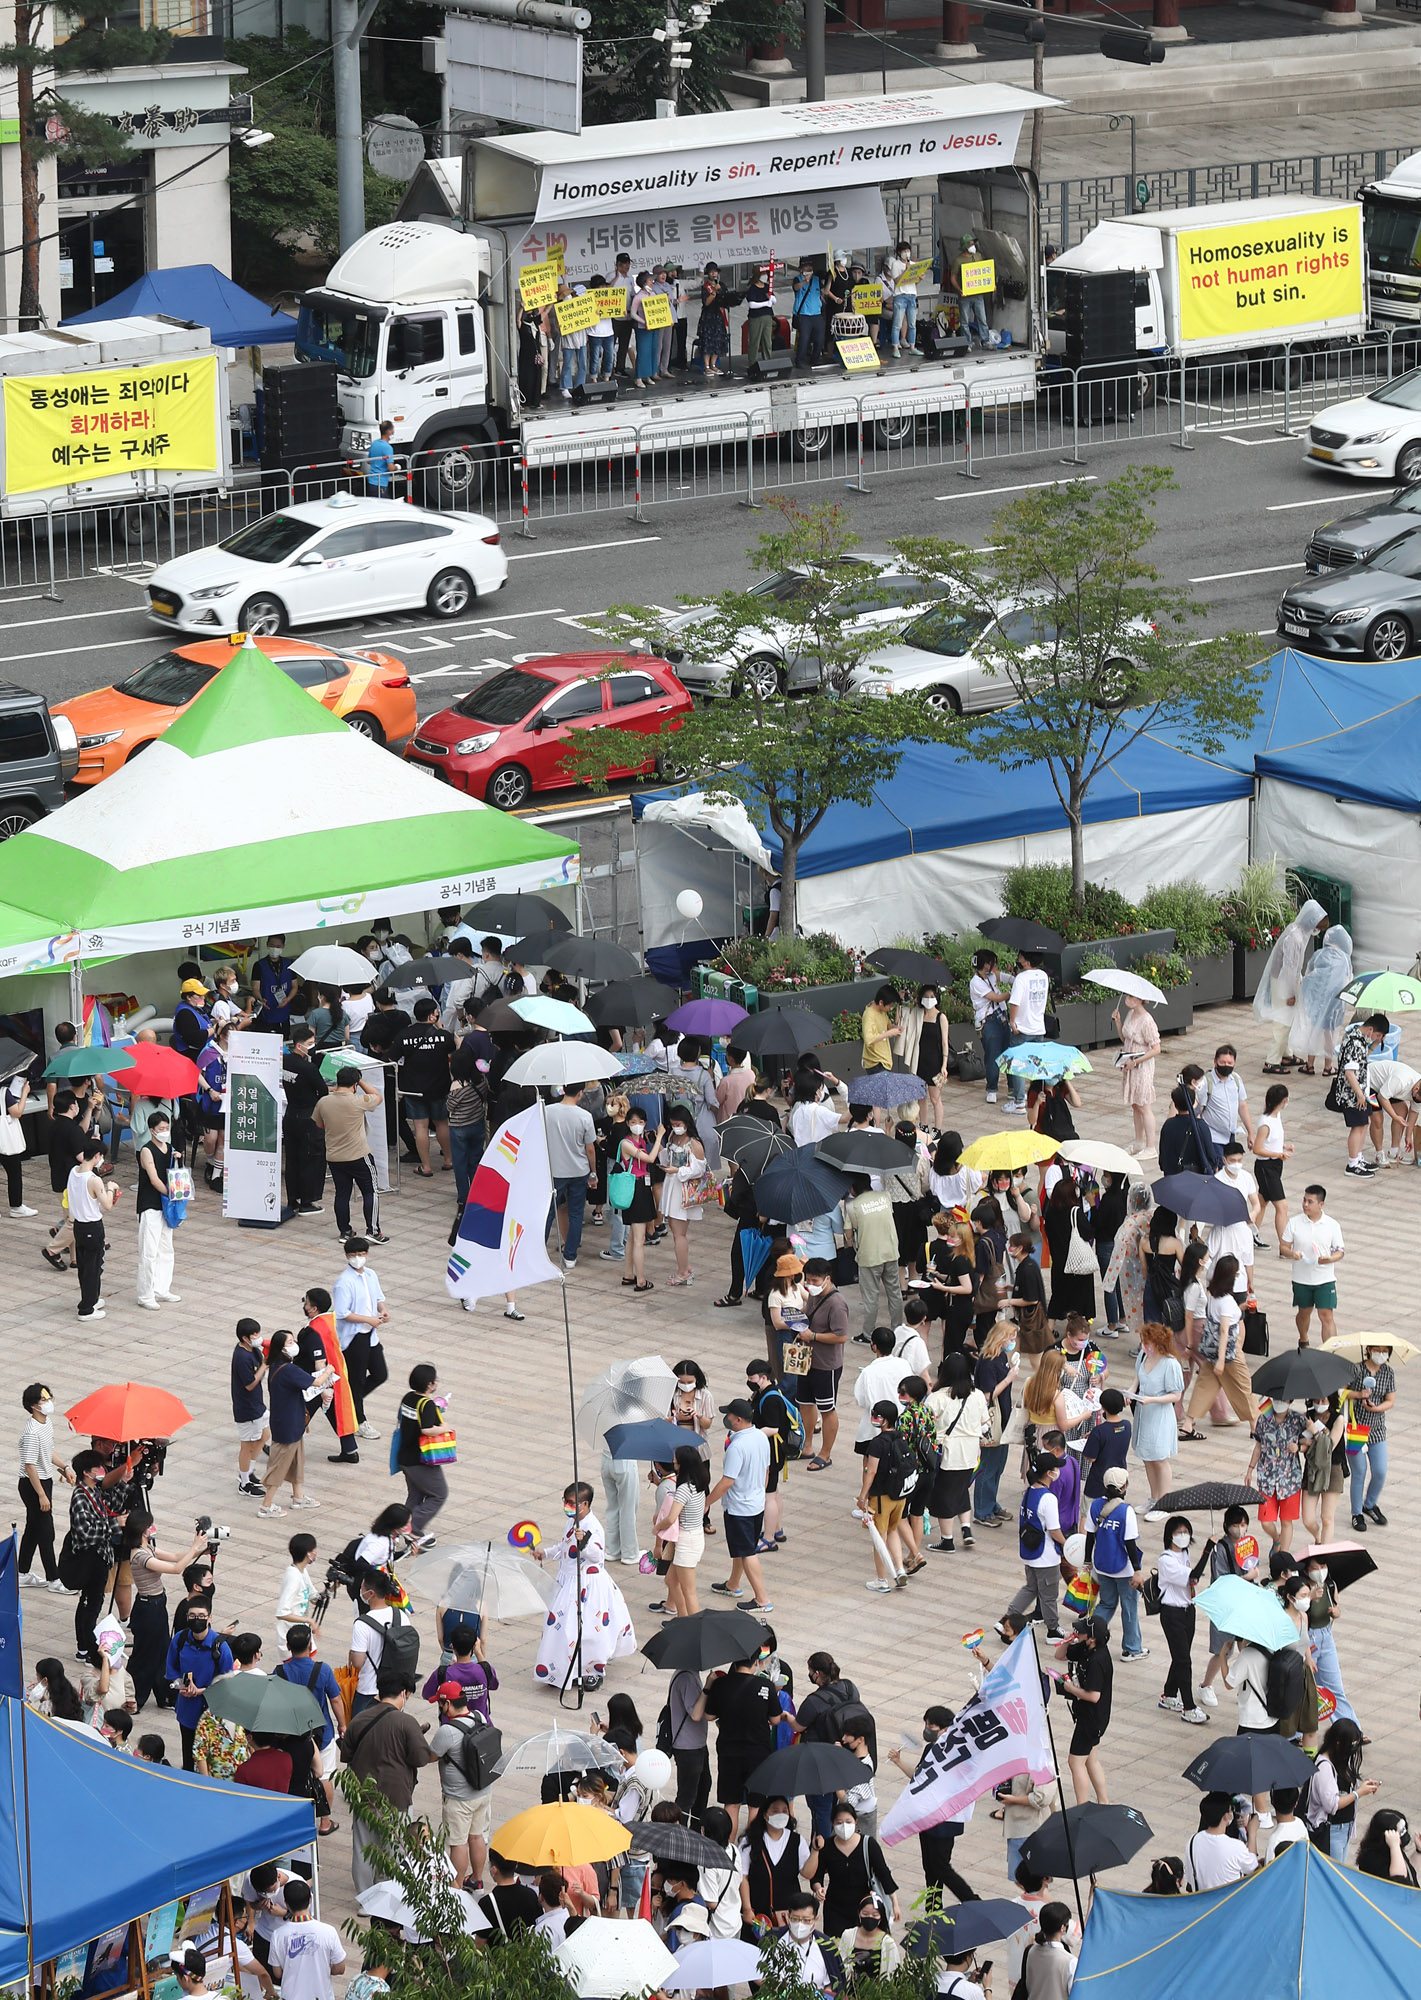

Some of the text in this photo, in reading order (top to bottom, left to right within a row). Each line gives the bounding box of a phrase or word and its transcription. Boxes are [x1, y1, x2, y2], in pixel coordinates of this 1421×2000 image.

[553, 132, 1002, 200] Homosexuality is sin. Repent! Return to Jesus.
[1190, 226, 1349, 264] Homosexuality is
[1191, 252, 1349, 290] not human rights
[520, 276, 537, 288] 동성애
[541, 293, 553, 304] 구원
[611, 287, 626, 296] 죄악
[1236, 284, 1306, 308] but sin.
[597, 298, 622, 307] 개하라!
[607, 308, 621, 316] 구원
[30, 372, 190, 410] 동성애는 죄악이다
[70, 408, 156, 435] 회개하라!
[52, 434, 171, 466] 예수는 구세주
[440, 876, 497, 900] 공식 기념품
[182, 918, 241, 938] 공식 기념품
[703, 984, 719, 996] 2022
[237, 1086, 258, 1100] 치열
[236, 1101, 258, 1115] 하게
[236, 1115, 257, 1129] 퀴어
[236, 1130, 258, 1144] 하라
[860, 1200, 879, 1210] Hello
[290, 1935, 306, 1950] NIKE
